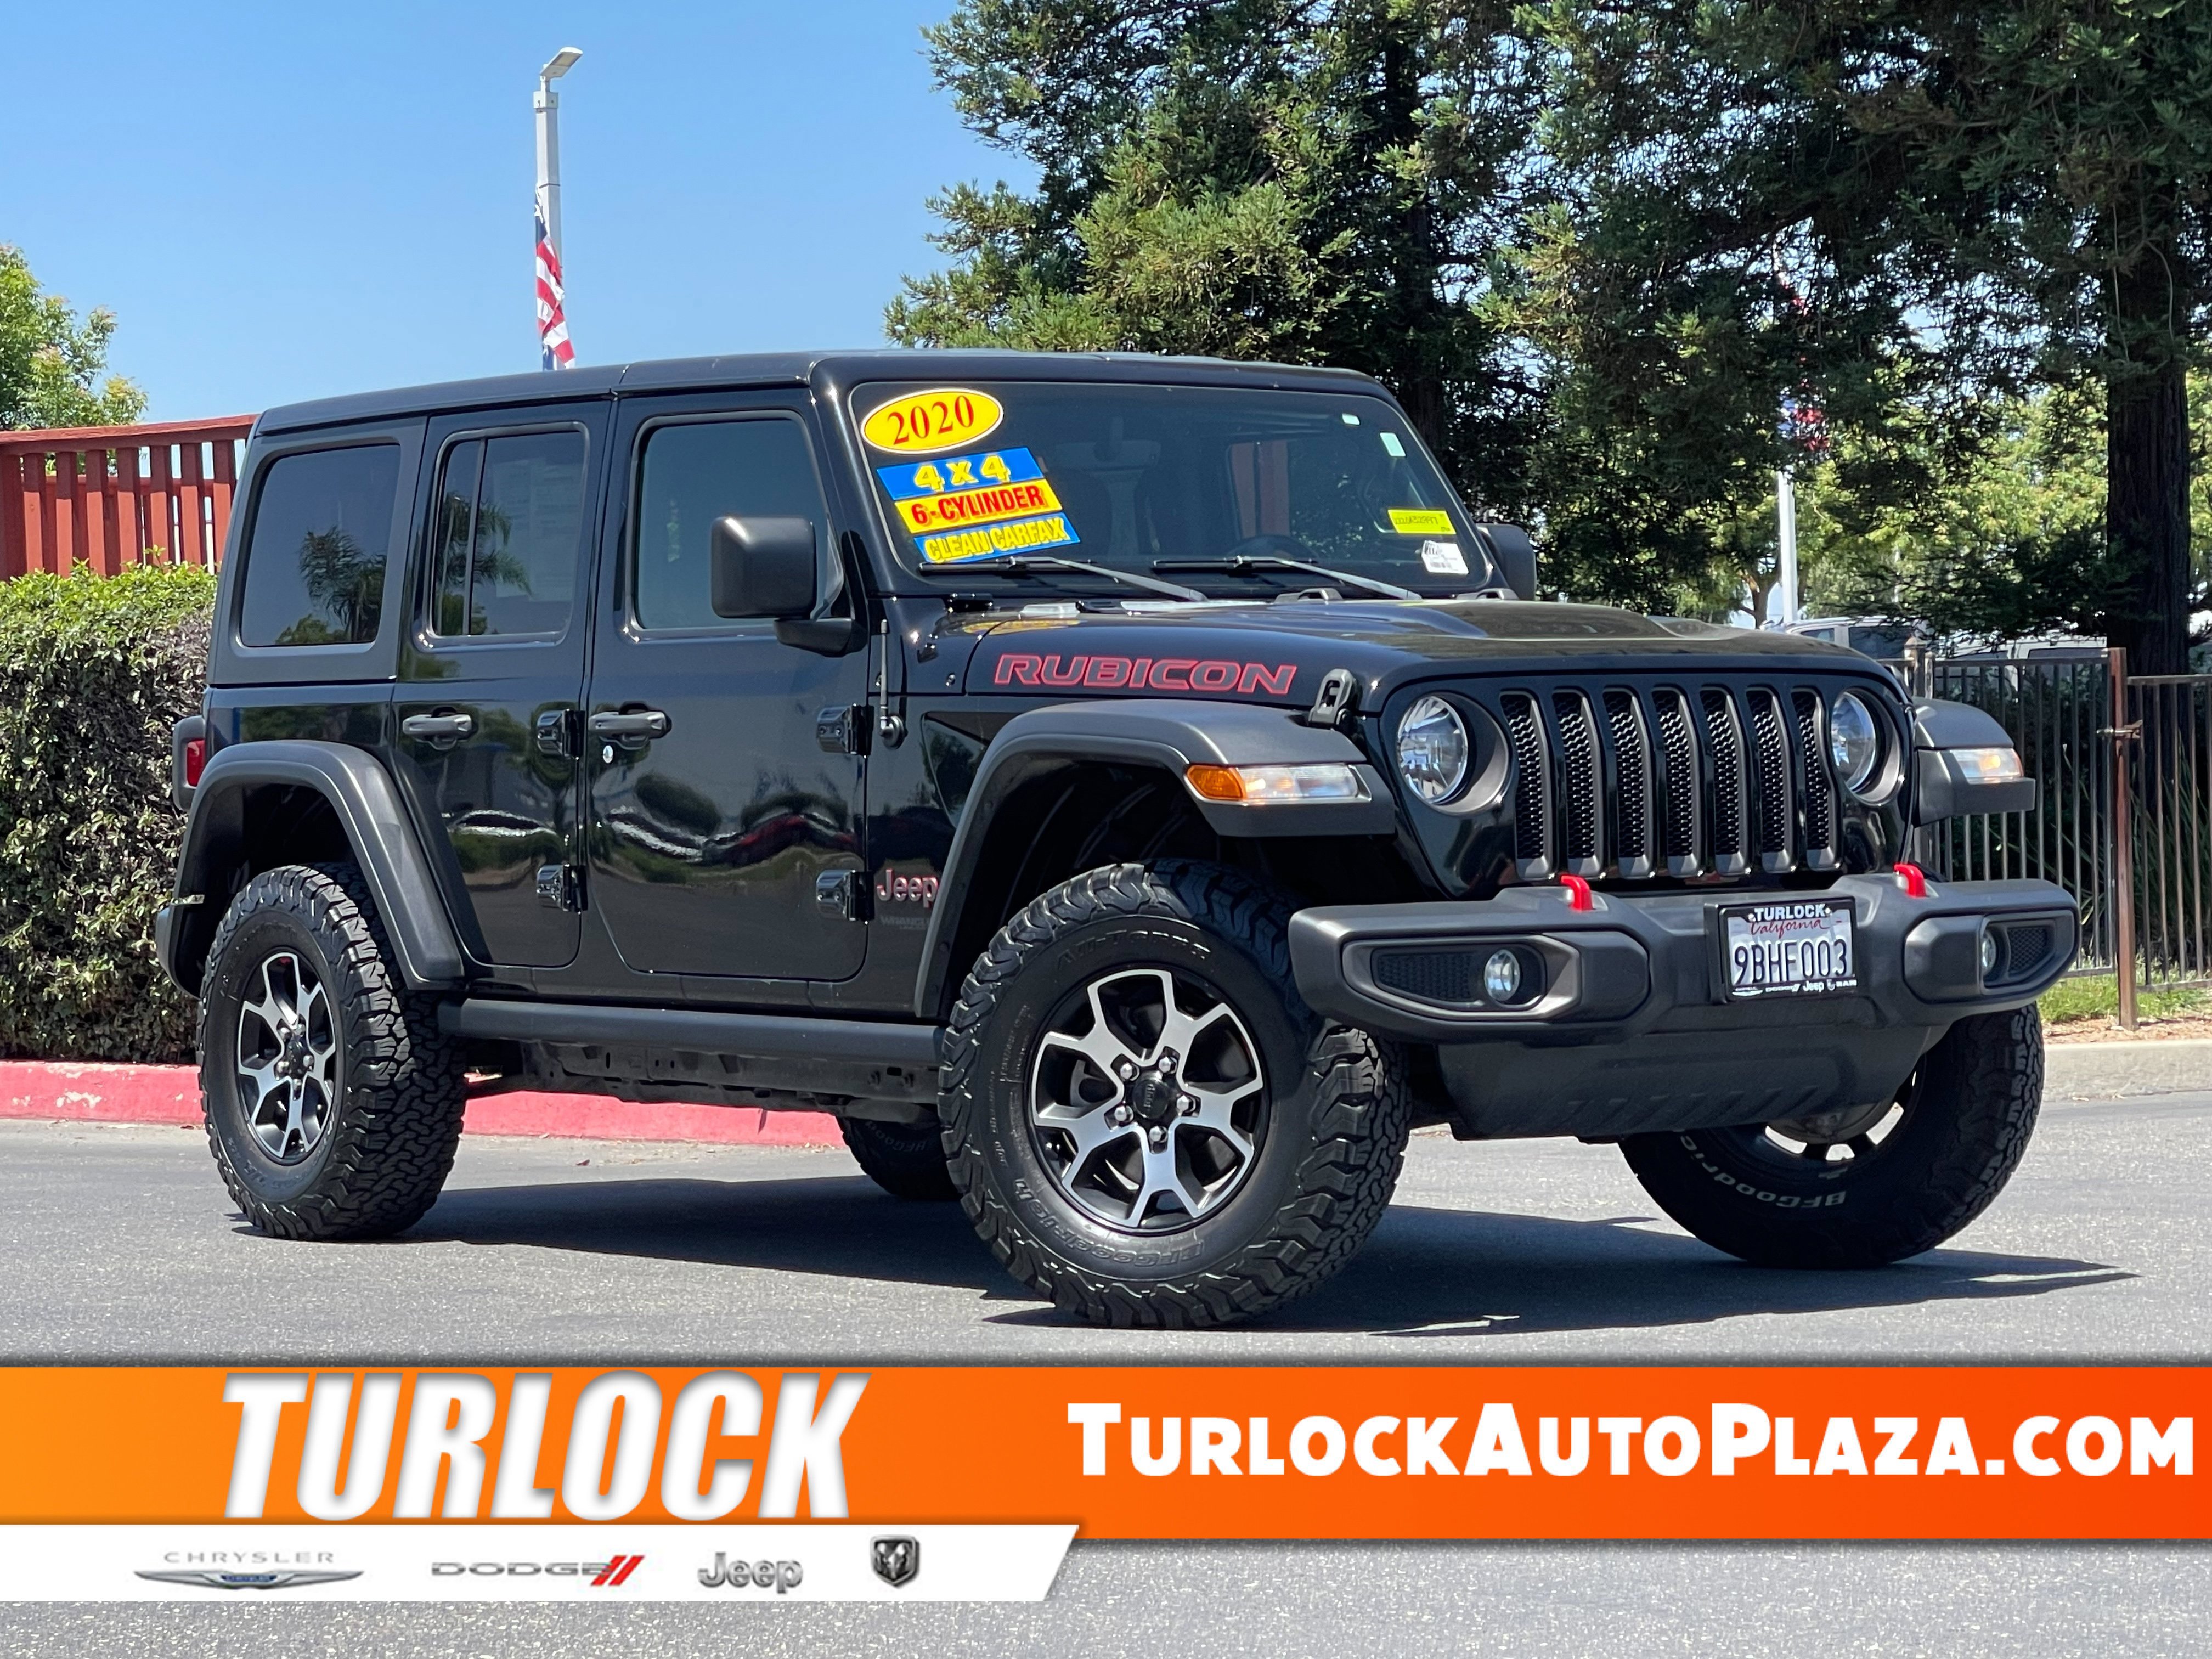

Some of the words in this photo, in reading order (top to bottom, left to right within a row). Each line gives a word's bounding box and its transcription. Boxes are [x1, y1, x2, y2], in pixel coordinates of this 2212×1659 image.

[888, 395, 974, 445] 2020
[911, 484, 1046, 526] 6-CYLINDER
[924, 530, 994, 563] CLEAN
[989, 517, 1070, 551] CARFAX
[994, 654, 1297, 695] RUBICON
[877, 868, 939, 909] Jeep
[1750, 918, 1831, 940] California
[1754, 904, 1826, 922] TURLOCK
[1734, 938, 1847, 986] 9BHF003
